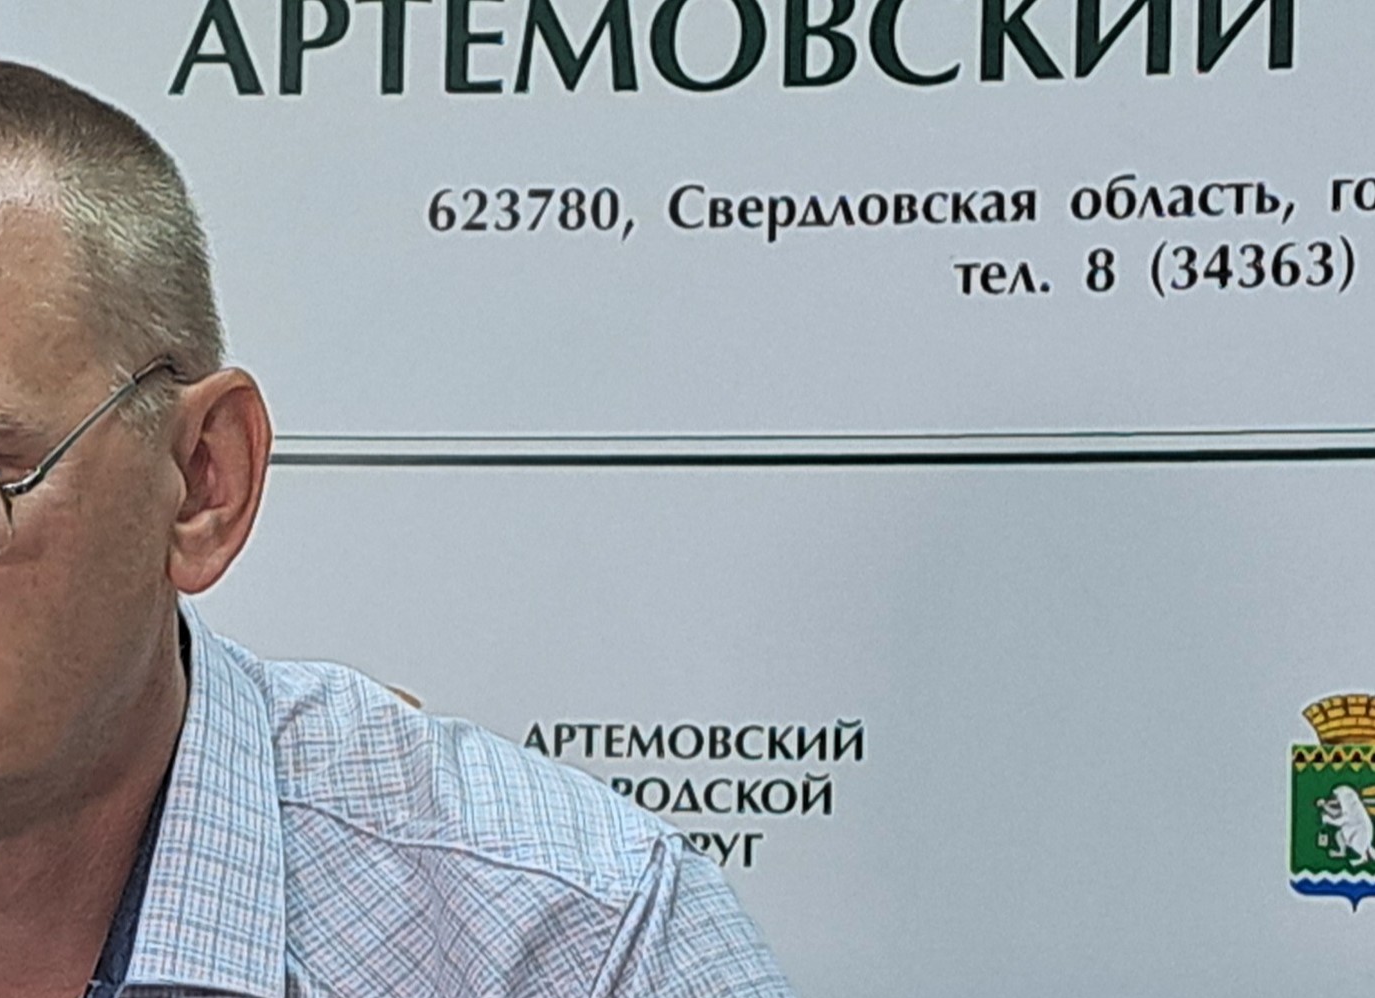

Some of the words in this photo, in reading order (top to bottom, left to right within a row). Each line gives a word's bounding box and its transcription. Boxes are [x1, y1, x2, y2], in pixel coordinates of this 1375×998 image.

[427, 187, 635, 241] 623780,
[668, 184, 1037, 243] Свердловская
[1070, 173, 1295, 225] область,
[953, 261, 1051, 295] тел.
[1086, 248, 1115, 292] 8
[1150, 235, 1355, 298] (34363)
[524, 719, 864, 761] АРТЕМОВСКИЙ
